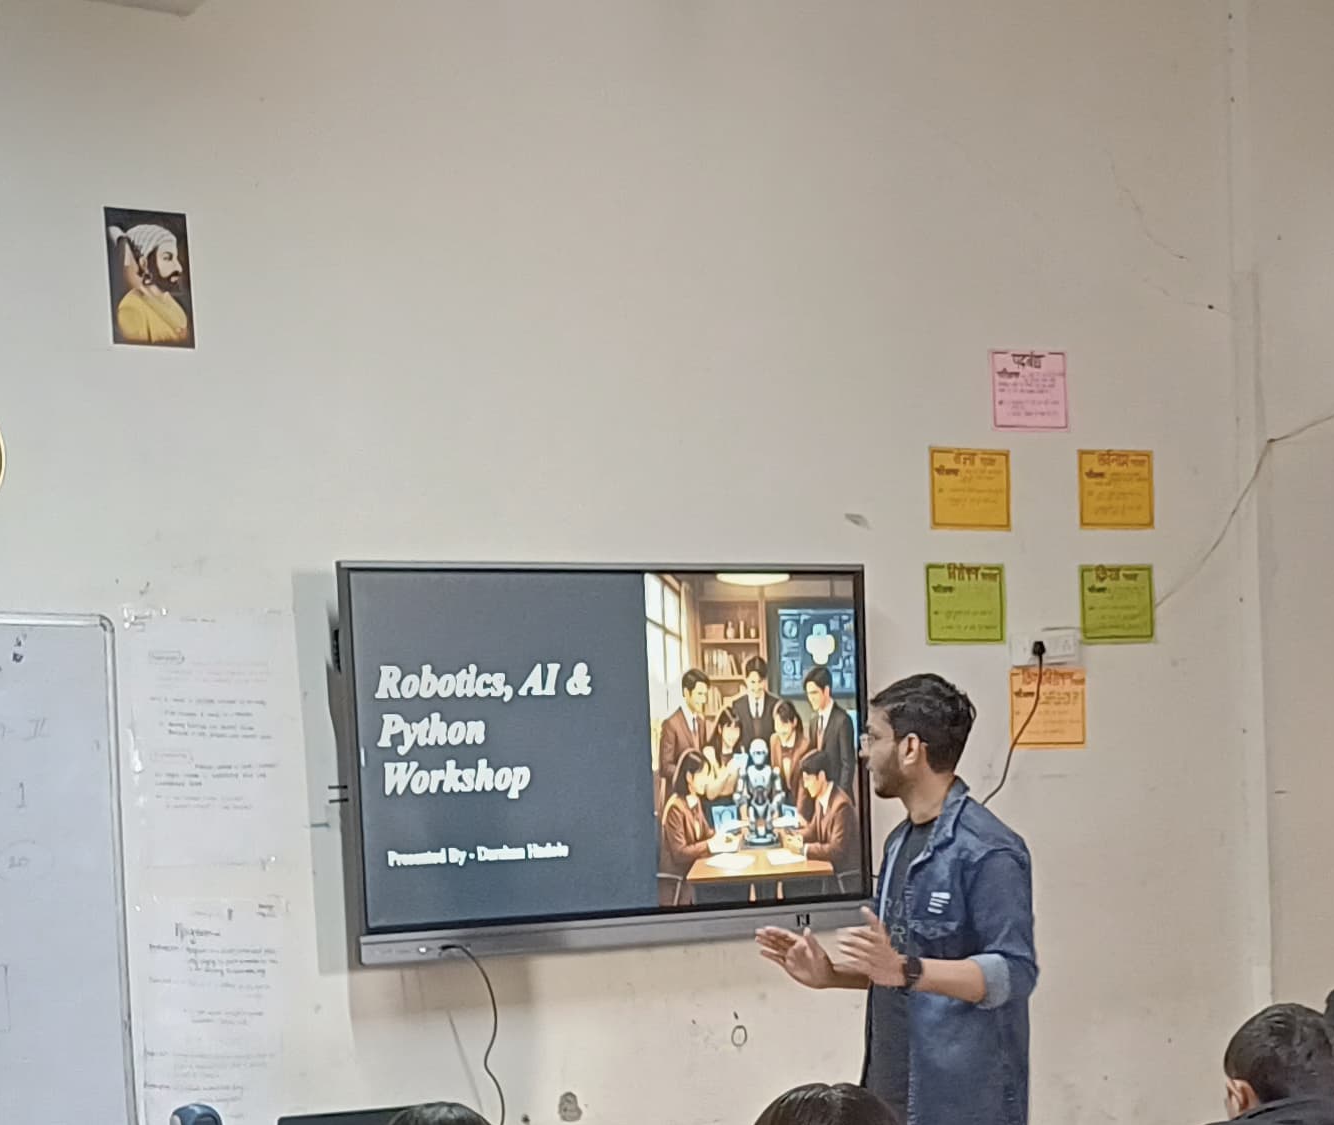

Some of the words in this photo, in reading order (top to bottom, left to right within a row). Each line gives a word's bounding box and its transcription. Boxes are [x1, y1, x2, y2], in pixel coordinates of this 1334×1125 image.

[375, 664, 514, 702] Robotics,
[518, 662, 561, 697] AI
[566, 662, 592, 697] &
[377, 713, 486, 755] Python
[382, 760, 531, 799] Workshop
